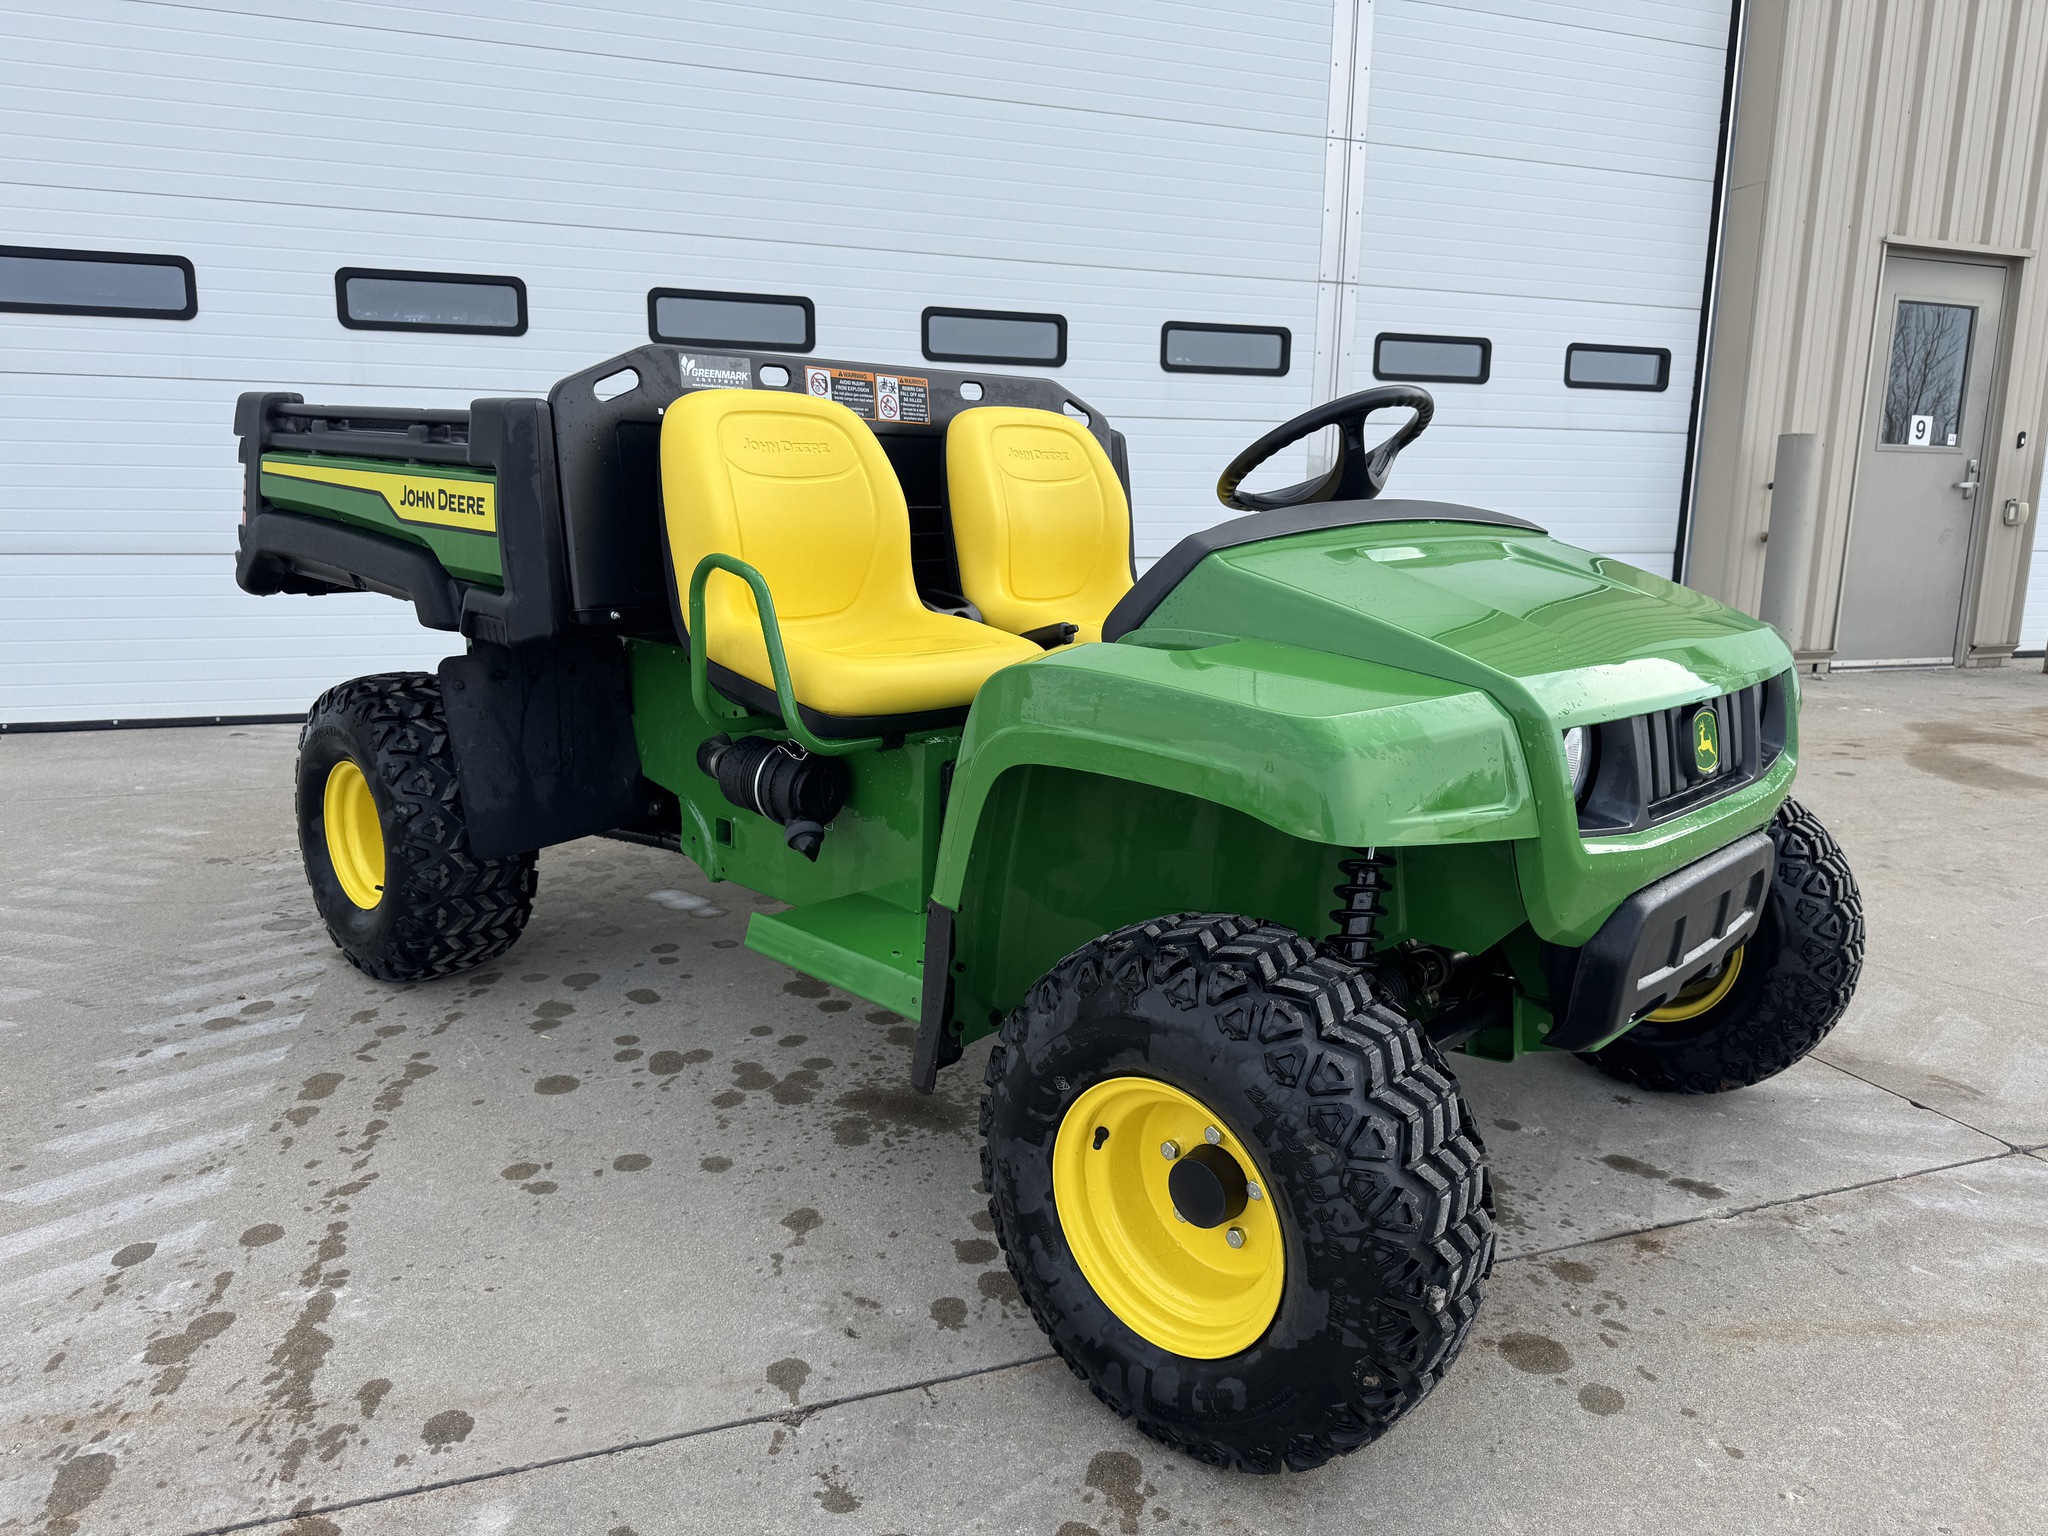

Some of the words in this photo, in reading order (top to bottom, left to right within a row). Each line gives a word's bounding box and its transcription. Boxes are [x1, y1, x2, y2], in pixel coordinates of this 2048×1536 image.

[692, 368, 748, 380] GREENMARK
[1915, 420, 1926, 440] 9
[743, 437, 780, 453] JOHN
[780, 440, 831, 454] DEERE
[1009, 446, 1034, 460] JOHN
[1033, 450, 1070, 461] DEERE
[400, 484, 434, 510] JOHN
[438, 488, 486, 516] DEERE
